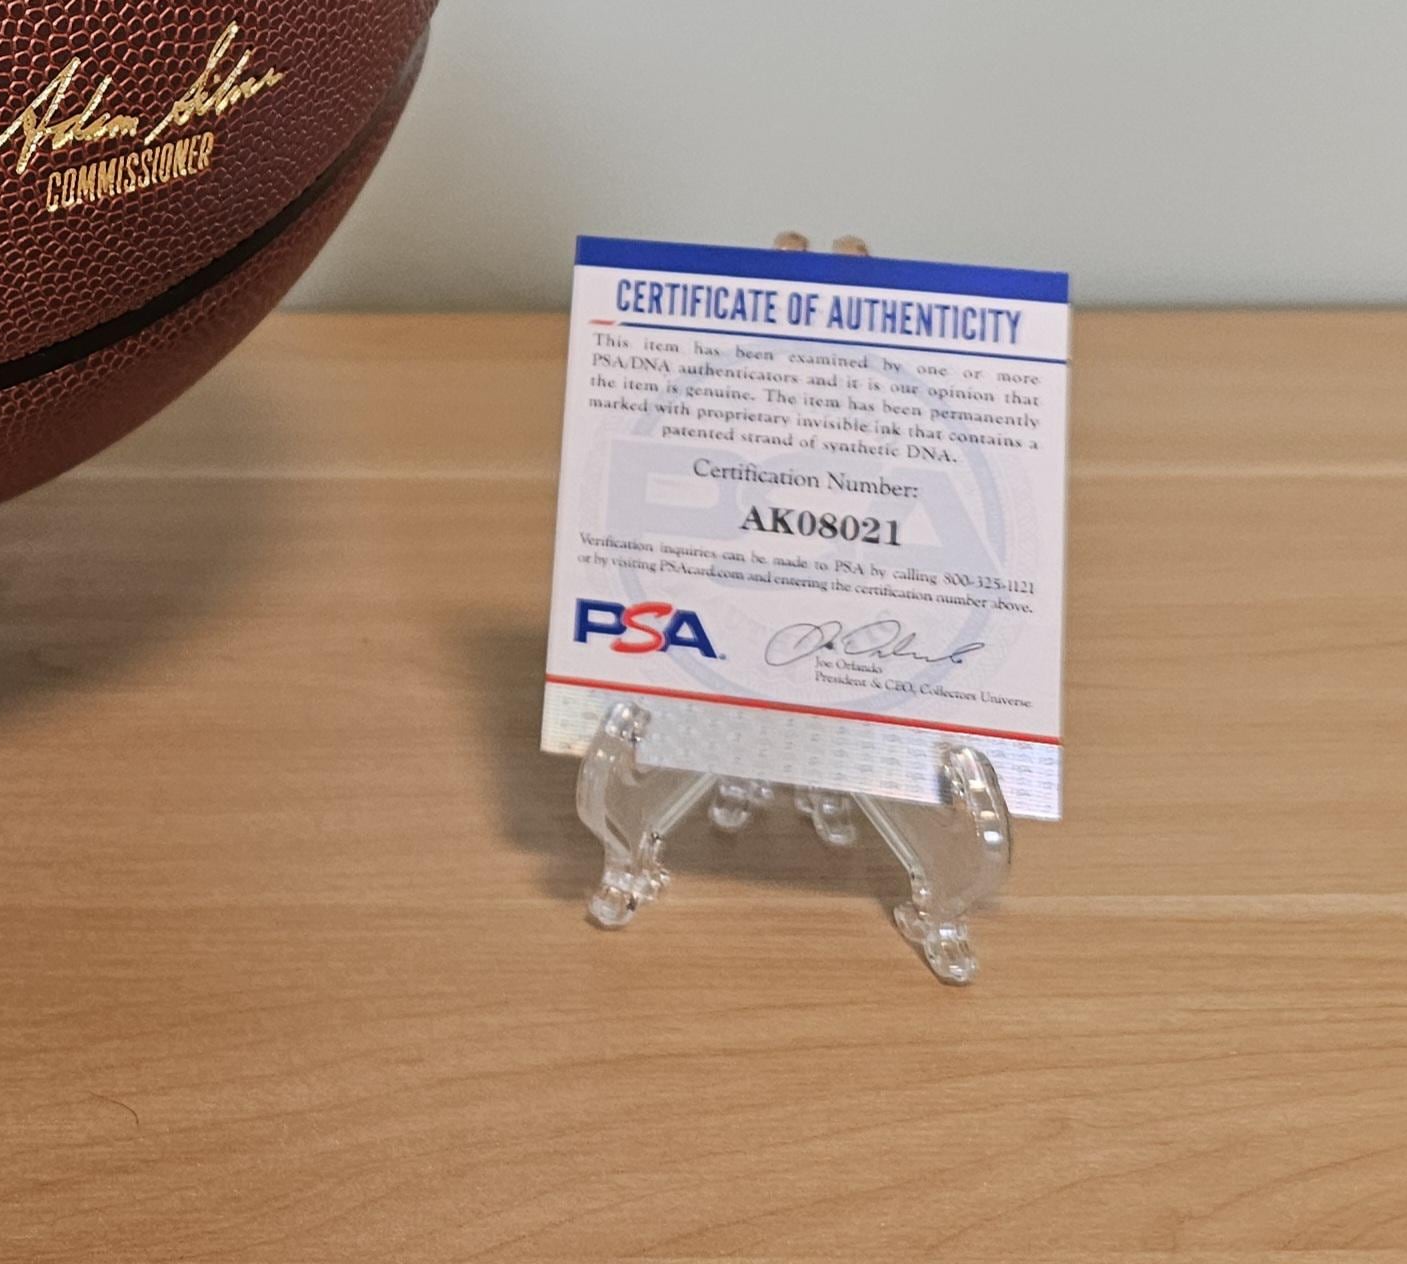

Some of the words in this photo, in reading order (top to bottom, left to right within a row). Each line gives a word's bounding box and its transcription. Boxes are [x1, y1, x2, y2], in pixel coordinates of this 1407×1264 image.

[45, 131, 215, 213] COMMISSIONER
[616, 278, 778, 324] CERTIFICATE
[787, 291, 820, 327] OF
[826, 295, 1022, 344] AUTHENTICITY
[592, 352, 671, 374] PSA/DNA
[678, 361, 799, 385] authenticators
[806, 373, 838, 388] and
[847, 376, 859, 390] it
[867, 378, 881, 392] is
[890, 383, 918, 395] our
[927, 387, 995, 404] opinion
[1003, 391, 1040, 407] that
[593, 332, 629, 349] This
[643, 336, 679, 353] item
[693, 340, 721, 357] has
[735, 344, 774, 361] been
[788, 349, 869, 370] examined
[882, 356, 904, 373] by
[915, 364, 948, 378] one
[963, 368, 983, 379] or
[996, 372, 1040, 386] more
[588, 396, 648, 413] marked
[654, 400, 690, 416] with
[697, 406, 790, 426] proprietary
[796, 414, 868, 433] invisible
[874, 421, 900, 436] ink
[908, 426, 943, 441] that
[948, 431, 1023, 449] contains
[1029, 440, 1039, 450] a
[590, 374, 617, 389] the
[623, 377, 659, 393] item
[666, 379, 679, 394] is
[685, 384, 756, 402] genuine.
[764, 388, 797, 405] The
[803, 394, 840, 409] item
[847, 397, 875, 412] has
[882, 401, 922, 416] been
[930, 407, 1040, 429] permanently
[662, 424, 735, 442] patented
[741, 430, 792, 447] strand
[799, 436, 817, 449] of
[823, 440, 900, 458] synthetic
[907, 444, 958, 464] DNA.
[692, 457, 820, 489] Certification
[827, 471, 919, 499] Number:
[739, 505, 902, 547] AK08021
[576, 553, 593, 564] or
[593, 553, 609, 567] by
[611, 556, 657, 574] visiting
[659, 559, 745, 581] PSAcard.com
[747, 570, 772, 584] and
[773, 573, 828, 592] entering
[830, 579, 852, 593] the
[854, 583, 933, 603] certification
[935, 591, 988, 609] number
[991, 598, 1033, 614] above.
[579, 532, 654, 552] Verification
[659, 540, 718, 559] inquiries
[722, 551, 745, 563] can
[751, 550, 767, 565] be
[772, 553, 808, 569] made
[814, 560, 829, 572] to
[834, 559, 865, 576] PSA
[870, 563, 888, 578] by
[892, 568, 938, 586] calling
[942, 571, 1035, 595] 800-325-1121
[573, 597, 719, 659] PSA
[814, 655, 833, 671] Joe
[834, 658, 883, 675] Orlando
[814, 671, 867, 689] President
[870, 678, 882, 690] &
[919, 684, 977, 703] Collectors
[980, 693, 1033, 709] Universe
